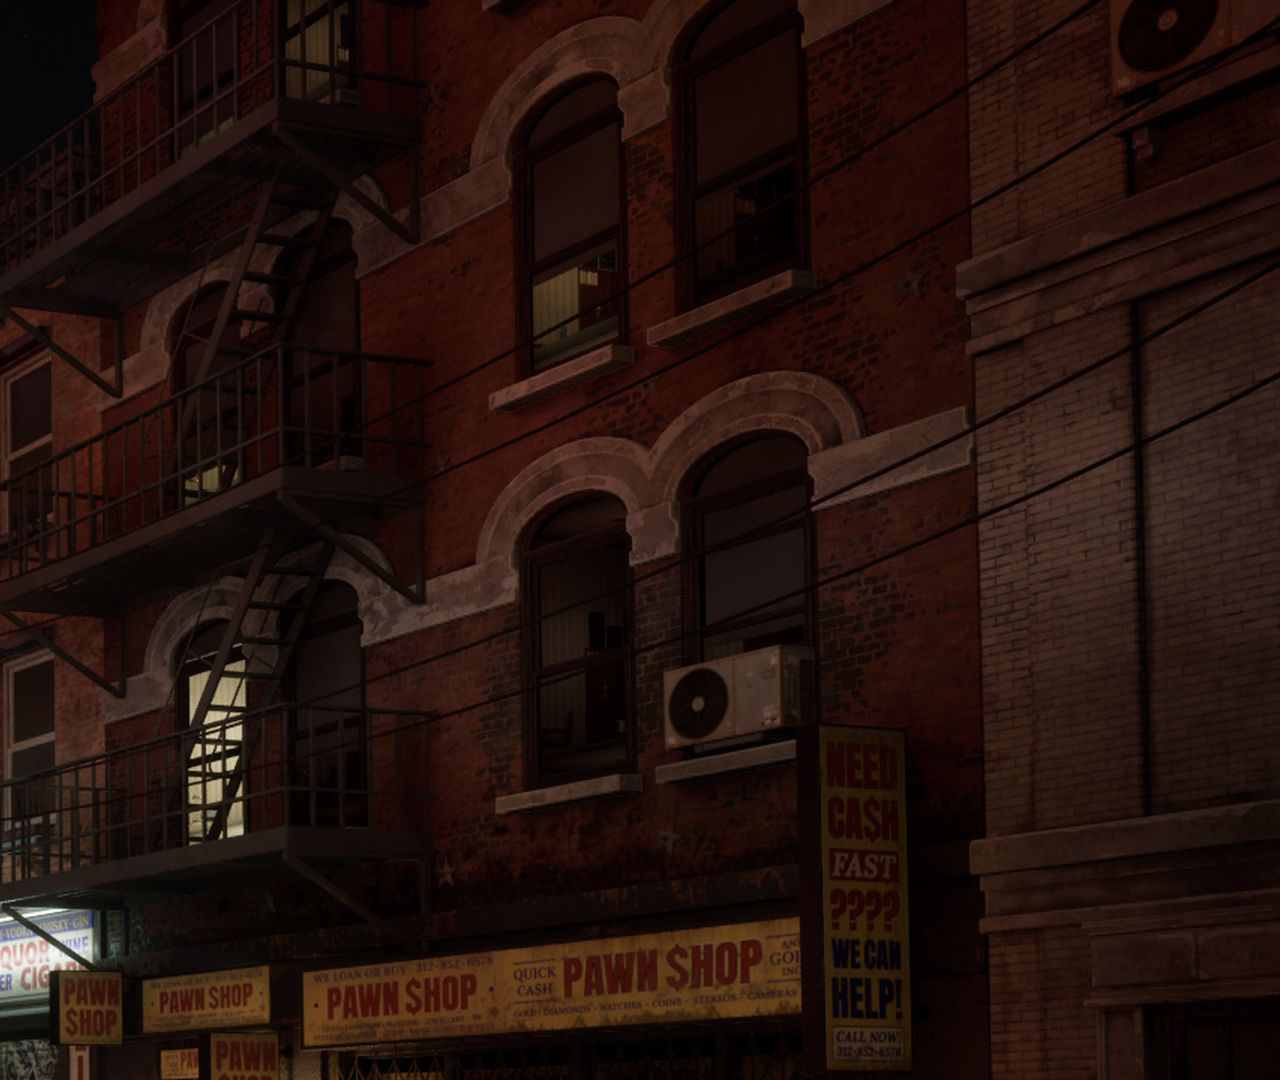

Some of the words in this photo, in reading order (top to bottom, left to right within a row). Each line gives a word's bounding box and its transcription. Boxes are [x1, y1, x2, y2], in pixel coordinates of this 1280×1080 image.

[827, 742, 898, 789] NEED
[833, 852, 897, 879] FAST
[563, 948, 658, 999] PAWN
[666, 938, 763, 991] $HOP
[832, 939, 860, 969] WE
[864, 940, 901, 970] CAN
[512, 966, 557, 983] QUICK
[64, 977, 120, 1005] PAWN
[159, 987, 206, 1014] PAWN
[328, 980, 400, 1020] PAWN
[405, 973, 478, 1016] $HOP
[516, 983, 554, 997] CASH
[832, 977, 903, 1019] HELP!
[836, 1031, 865, 1044] CALL
[216, 1040, 277, 1071] PAWN
